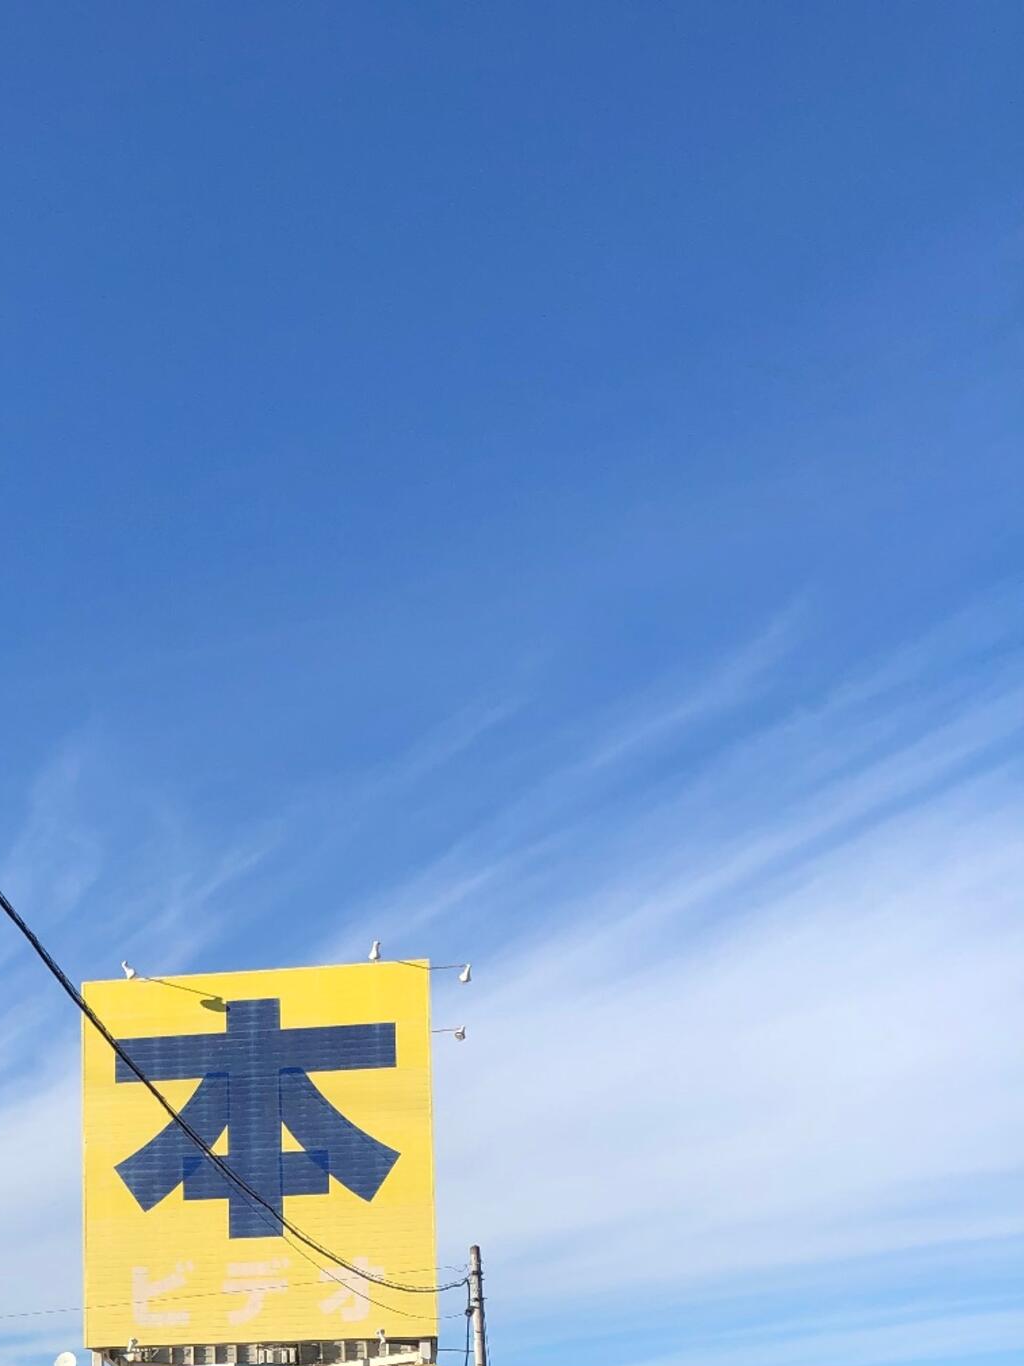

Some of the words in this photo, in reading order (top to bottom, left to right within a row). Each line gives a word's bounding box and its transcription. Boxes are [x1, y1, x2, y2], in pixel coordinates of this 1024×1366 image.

[114, 998, 401, 1239] 本
[130, 1256, 385, 1327] ビデオ
